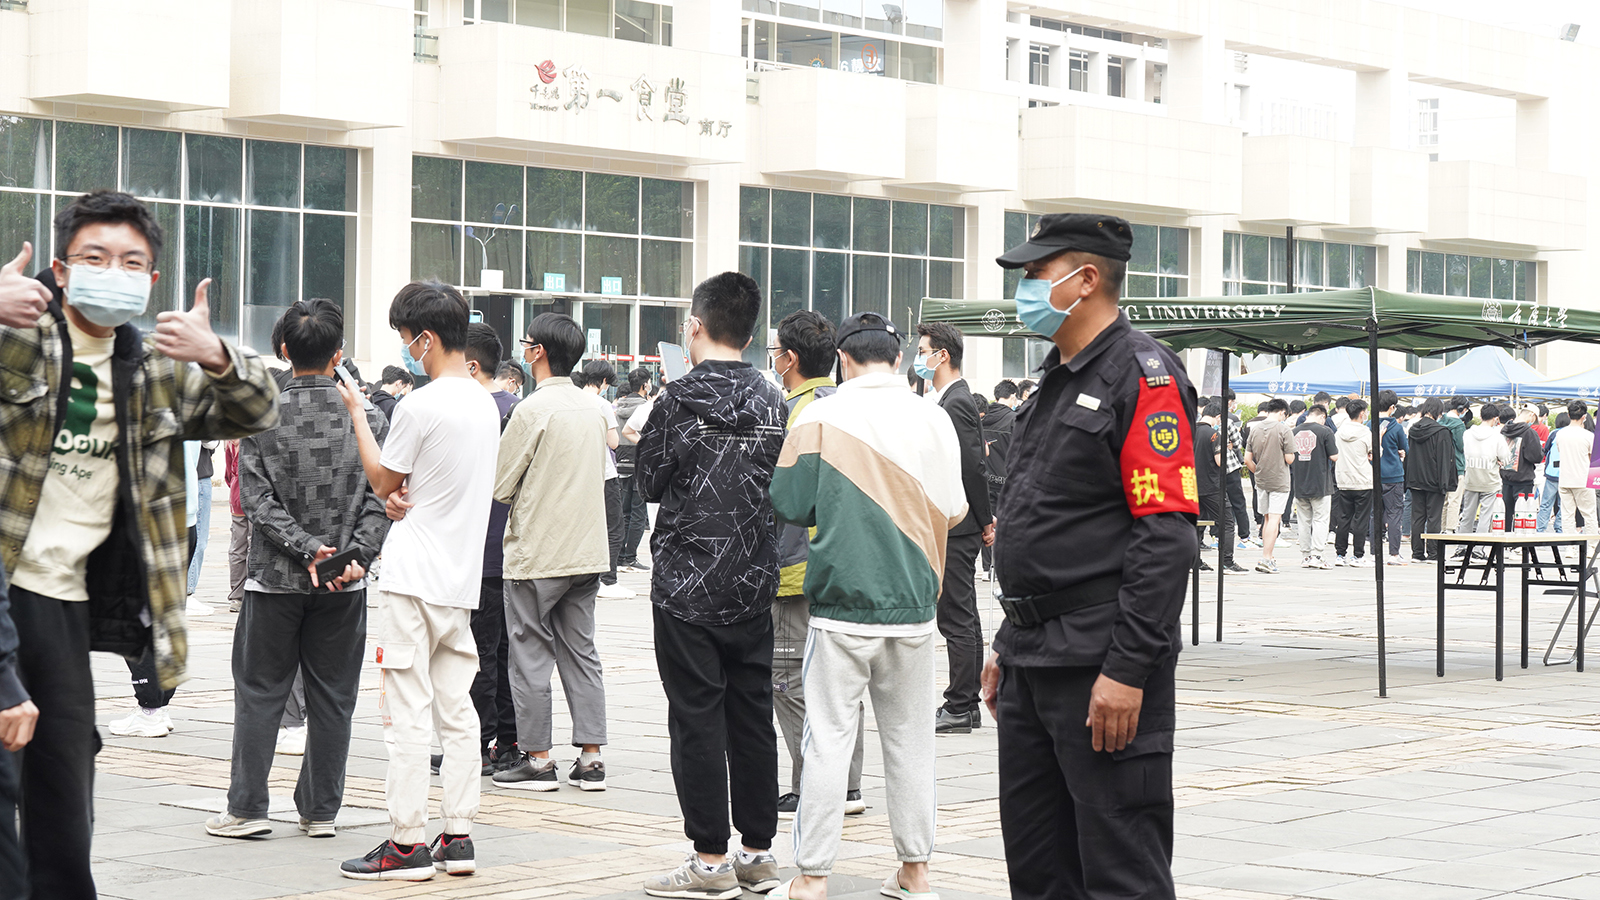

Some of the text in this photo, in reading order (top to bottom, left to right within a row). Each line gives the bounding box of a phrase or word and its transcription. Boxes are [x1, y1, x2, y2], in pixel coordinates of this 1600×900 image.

[563, 64, 690, 126] 第一食堂
[545, 275, 564, 290] 出口
[603, 278, 621, 293] 出口
[1145, 304, 1286, 321] UNIVERSITY
[1508, 303, 1568, 328] 重庆大学
[1280, 381, 1308, 393] 重庆大学
[1295, 437, 1315, 448] STOP
[70, 464, 93, 481] Ape
